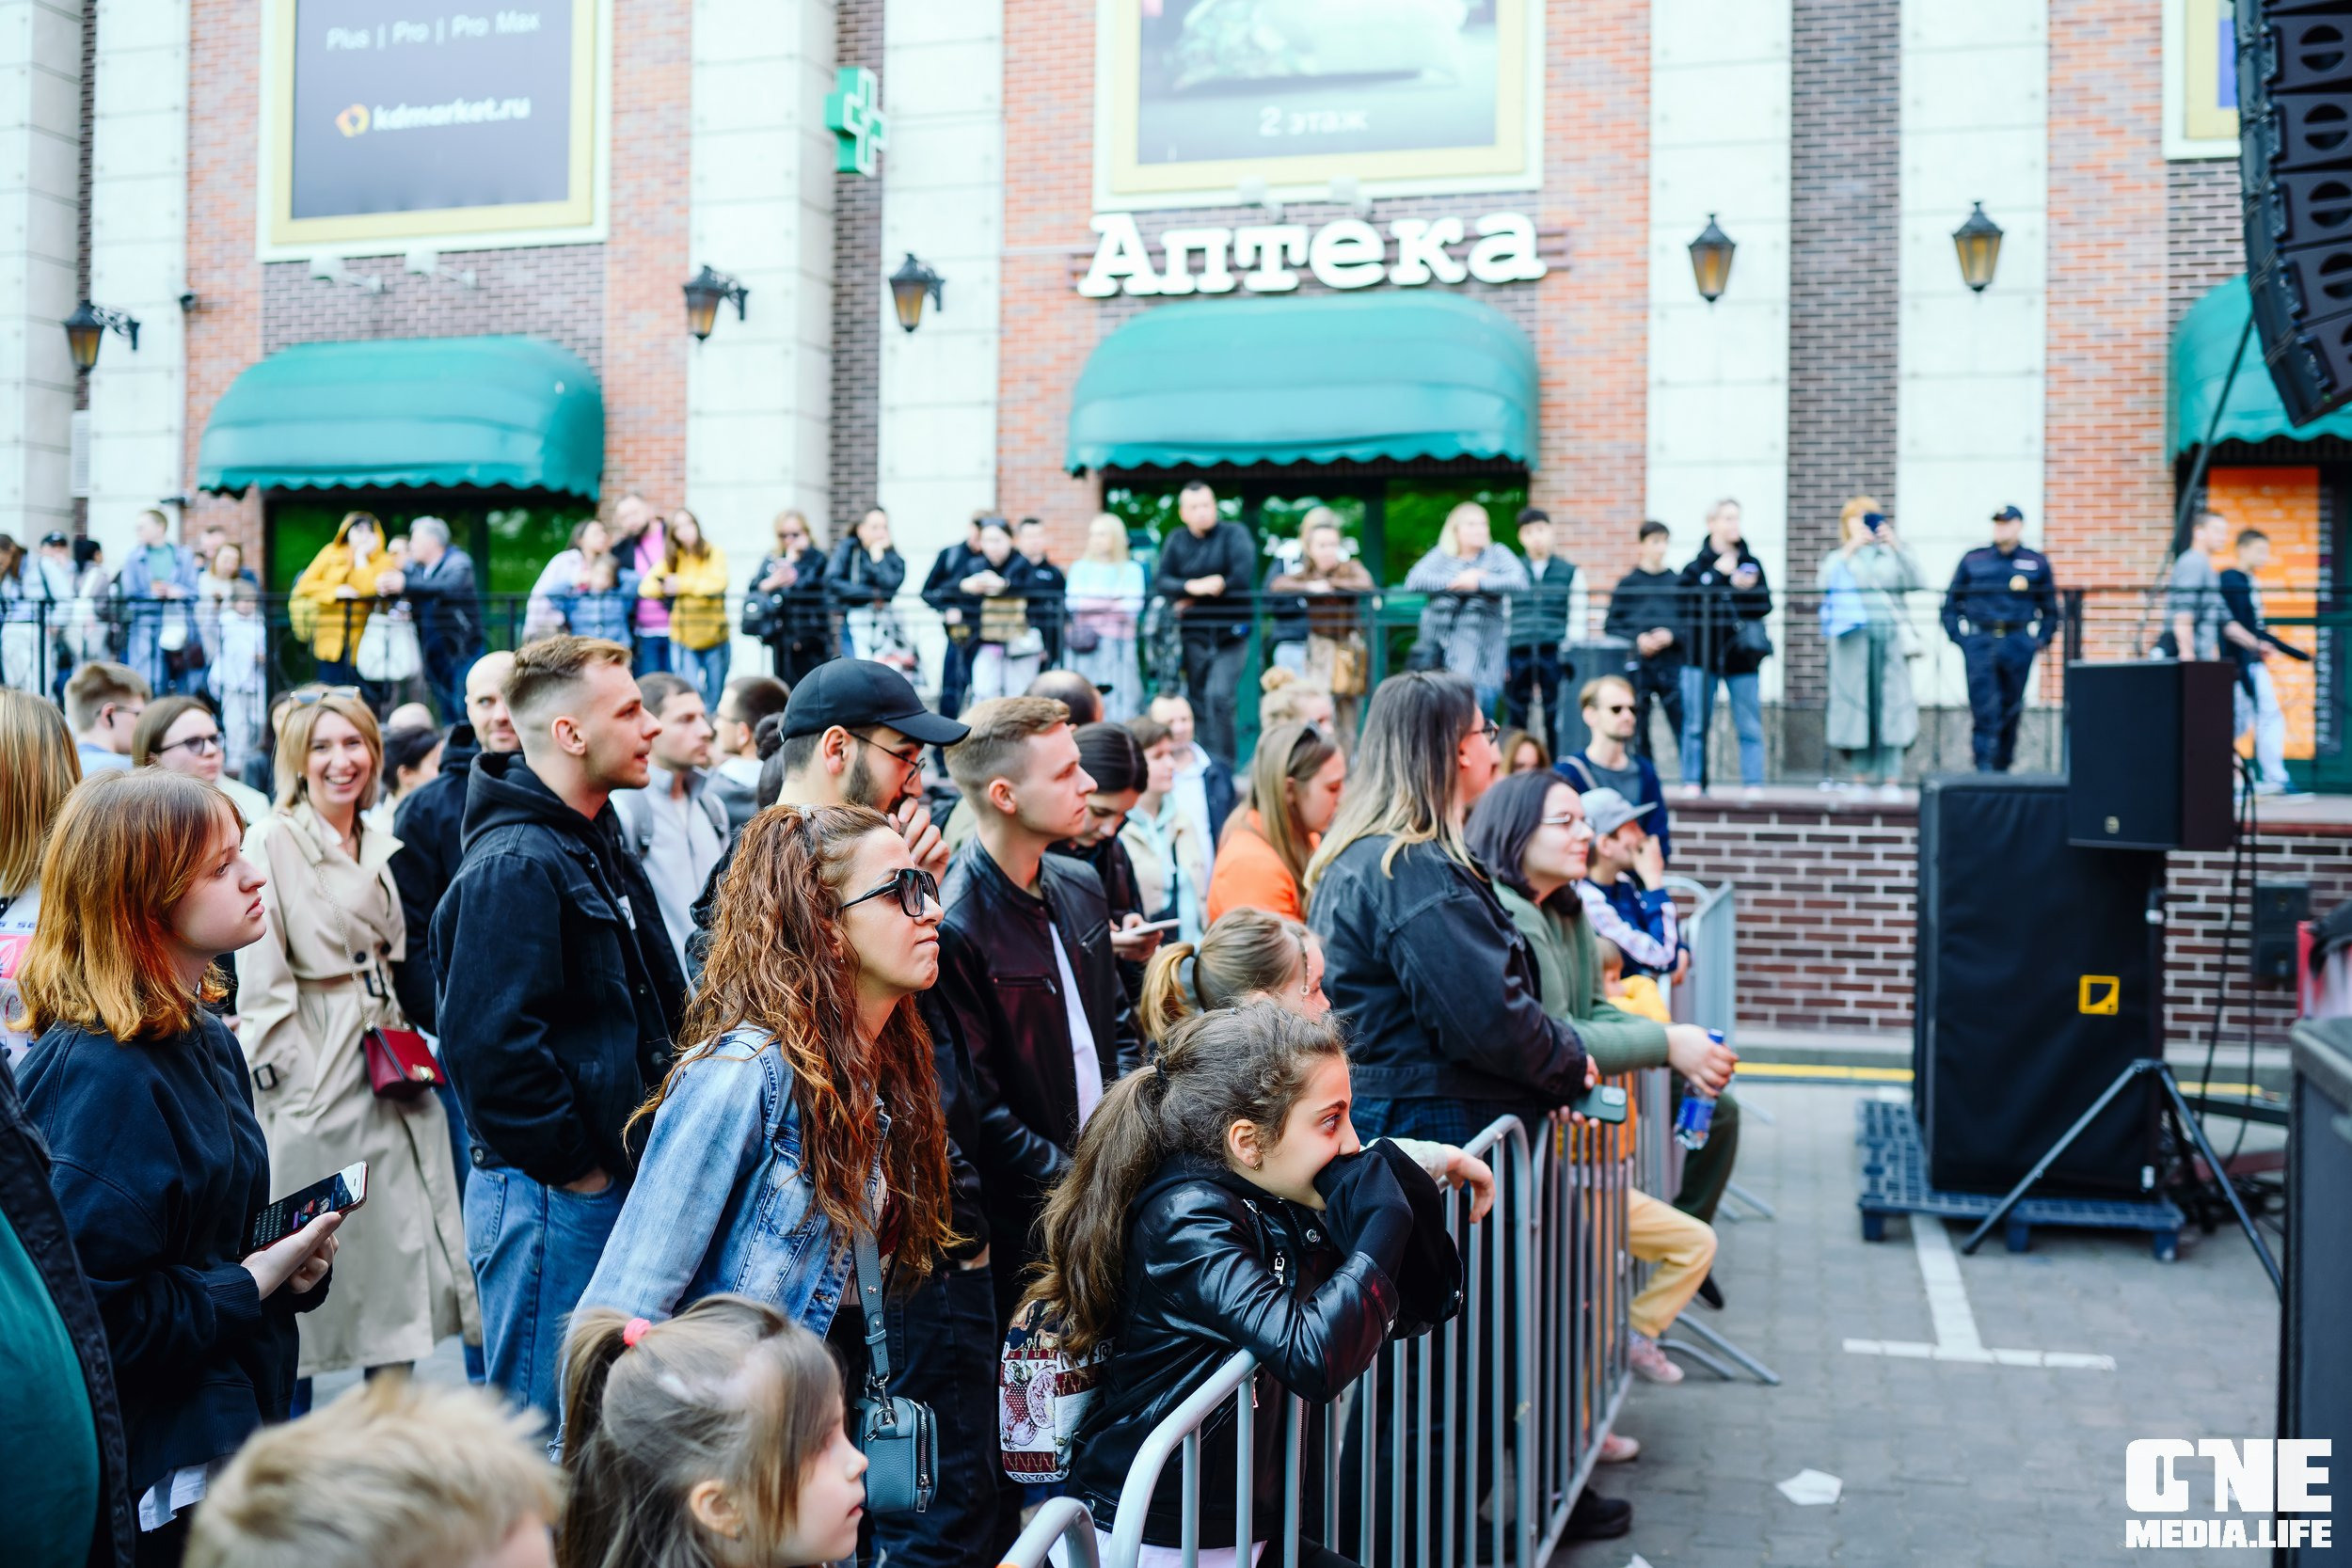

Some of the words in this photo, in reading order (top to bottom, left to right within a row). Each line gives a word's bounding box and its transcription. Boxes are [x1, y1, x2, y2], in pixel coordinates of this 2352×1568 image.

[326, 27, 371, 51] Plus
[392, 21, 429, 44] Pro
[452, 14, 490, 39] Pro
[495, 9, 541, 34] Max
[373, 97, 531, 131] kdmarket.ru
[1259, 105, 1282, 137] 2
[1287, 108, 1370, 135] этаж
[1077, 212, 1548, 297] Аптека
